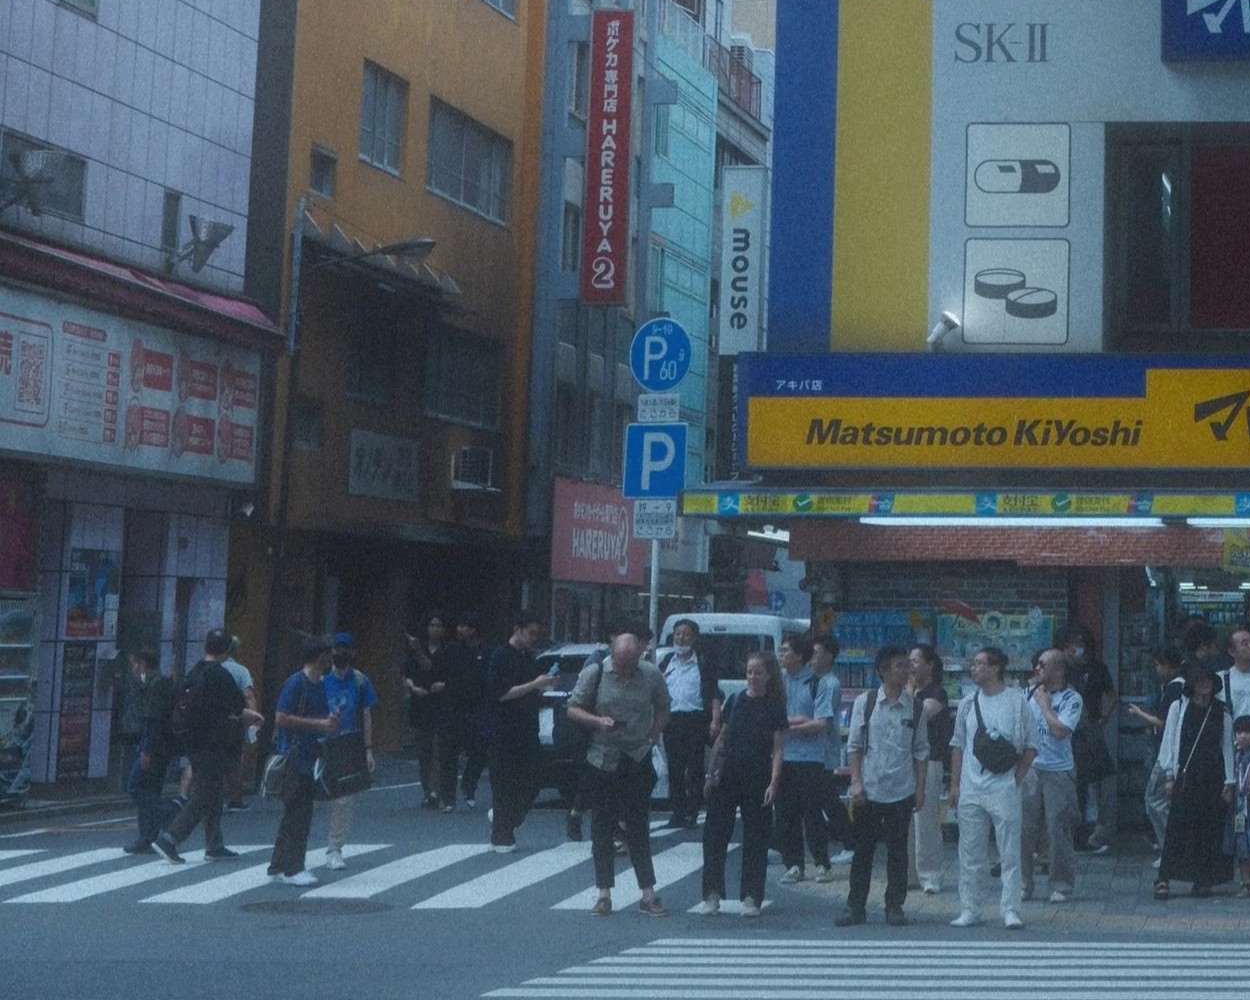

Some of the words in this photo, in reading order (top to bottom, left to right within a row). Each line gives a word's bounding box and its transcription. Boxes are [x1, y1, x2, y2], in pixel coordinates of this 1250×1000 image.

[603, 19, 621, 113] ポケカ専門店
[597, 118, 618, 253] HARERUYA
[729, 227, 750, 332] mouse
[643, 336, 668, 380] P
[659, 360, 677, 381] 60
[775, 379, 823, 392] アキバ店
[806, 419, 1007, 447] Matsumoto
[1013, 420, 1143, 447] KiYoshi
[641, 432, 676, 492] P
